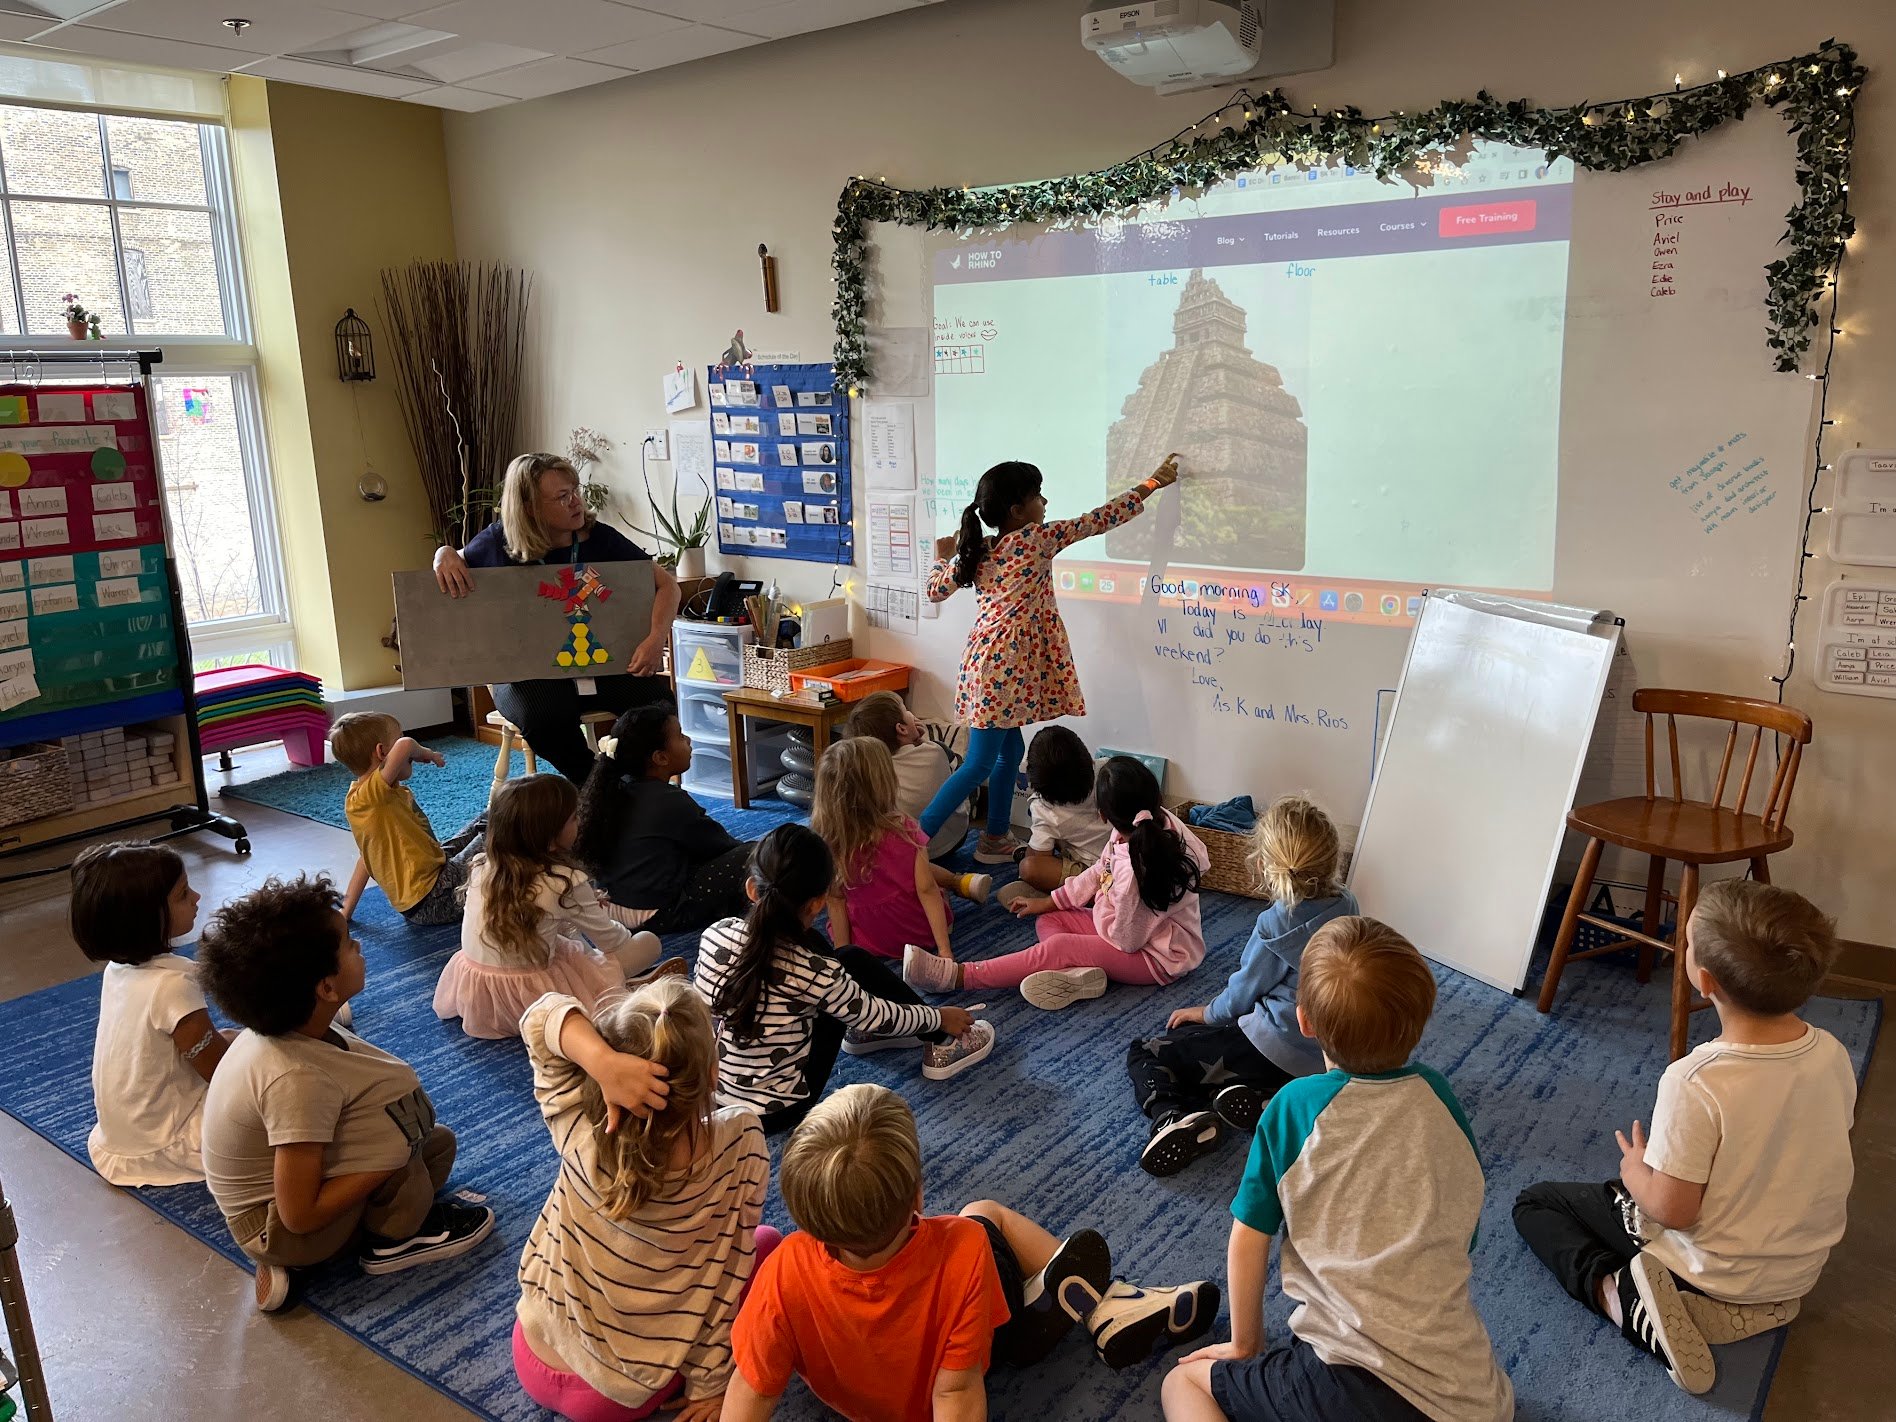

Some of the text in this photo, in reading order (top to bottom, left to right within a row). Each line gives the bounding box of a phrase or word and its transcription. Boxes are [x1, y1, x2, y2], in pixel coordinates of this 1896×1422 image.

[1119, 9, 1140, 19] EPSON
[1652, 181, 1750, 207] Stay and play
[1456, 210, 1519, 226] Free Training
[1655, 213, 1684, 228] Price
[1317, 225, 1360, 237] Resources
[1379, 220, 1415, 232] Courses
[1217, 235, 1235, 247] Blog
[1264, 230, 1299, 242] Tutorials
[968, 250, 1002, 261] HOW TO
[968, 259, 996, 270] RHINO
[1285, 263, 1316, 279] floor
[1652, 261, 1674, 270] Ezra
[1148, 273, 1178, 287] table
[1650, 286, 1676, 297] Caleb
[955, 315, 966, 329] We
[969, 319, 980, 328] can
[983, 319, 995, 327] use
[20, 440, 40, 451] your
[53, 429, 98, 447] favorite
[103, 430, 112, 441] ?
[954, 475, 968, 489] days
[96, 487, 128, 503] Caleb
[26, 495, 61, 511] Anna
[1689, 500, 1704, 513] list
[1869, 502, 1887, 513] I'm
[102, 556, 135, 572] Owen
[1101, 581, 1112, 590] 25
[1151, 575, 1186, 595] Good
[1199, 582, 1260, 608] morning
[101, 586, 134, 600] Warren
[1177, 598, 1217, 626] Today
[1233, 608, 1246, 621] is
[1193, 621, 1214, 639] did
[1226, 629, 1245, 645] you
[1254, 628, 1271, 645] do
[1846, 632, 1865, 644] I'm
[1872, 635, 1880, 644] at
[1837, 649, 1861, 658] Caleb
[696, 658, 703, 673] 3
[1875, 661, 1896, 670] Price
[1192, 667, 1224, 691] Love,
[1834, 673, 1859, 681] William
[1870, 676, 1890, 684] Aviel
[1237, 697, 1248, 717] K
[1254, 704, 1275, 721] and
[1284, 704, 1315, 726] Mrs.
[1318, 708, 1349, 731] Rios
